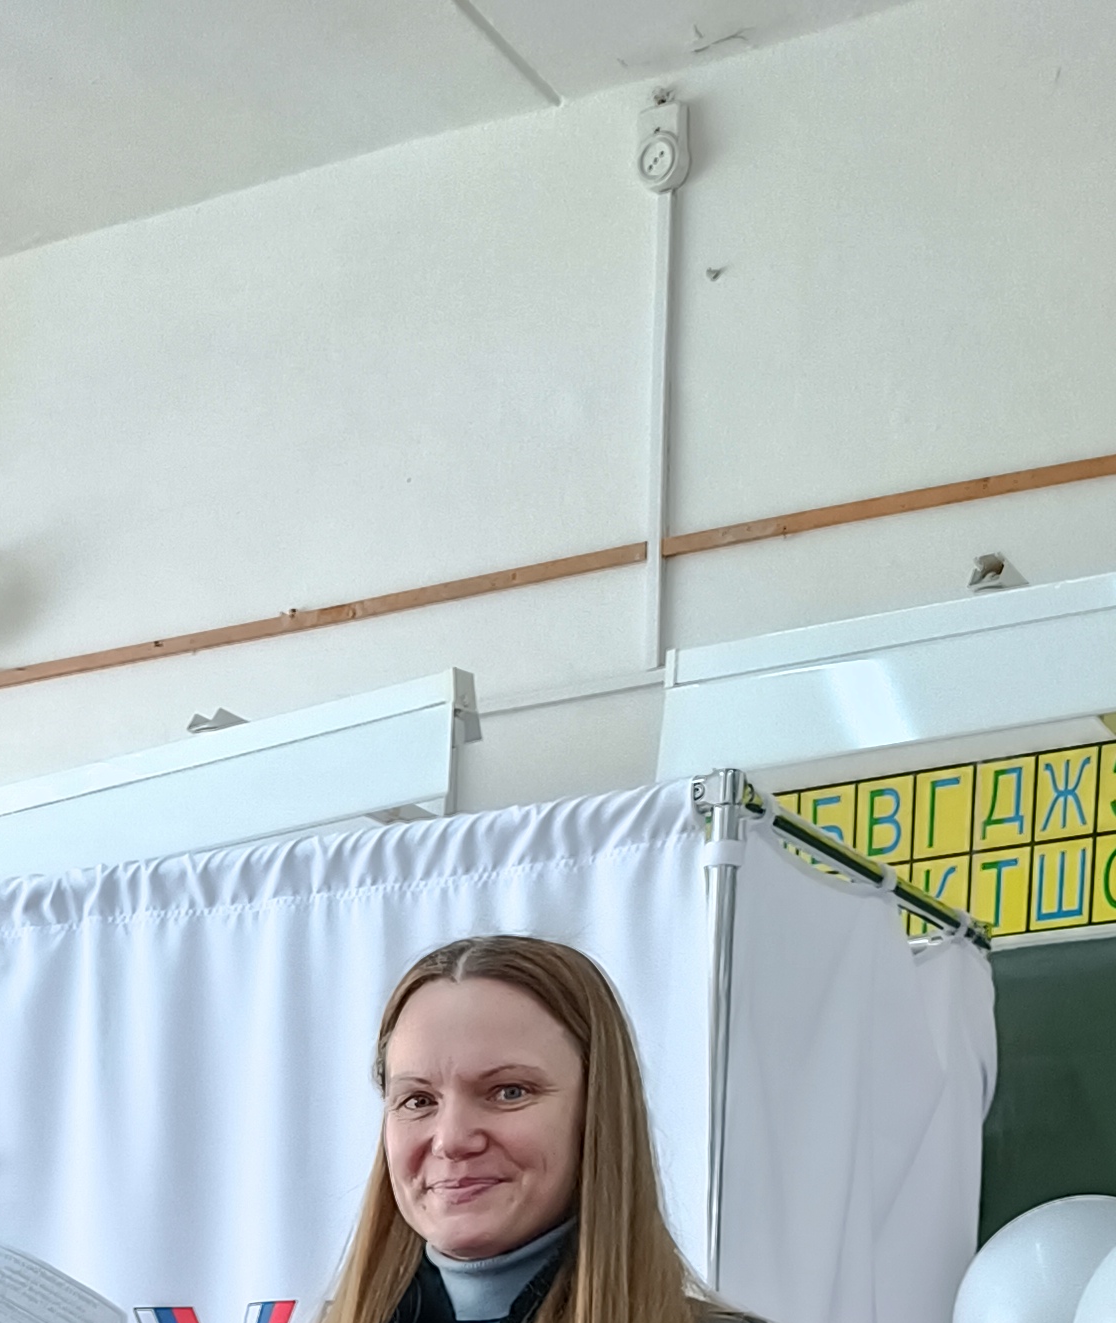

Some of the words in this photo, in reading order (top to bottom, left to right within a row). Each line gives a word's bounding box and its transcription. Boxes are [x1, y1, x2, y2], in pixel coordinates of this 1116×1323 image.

[867, 788, 902, 857] В
[928, 776, 960, 848] Г
[981, 766, 1025, 841] Д
[1040, 756, 1092, 832] Ж
[981, 857, 1019, 928] Т
[1036, 848, 1087, 922] Ш
